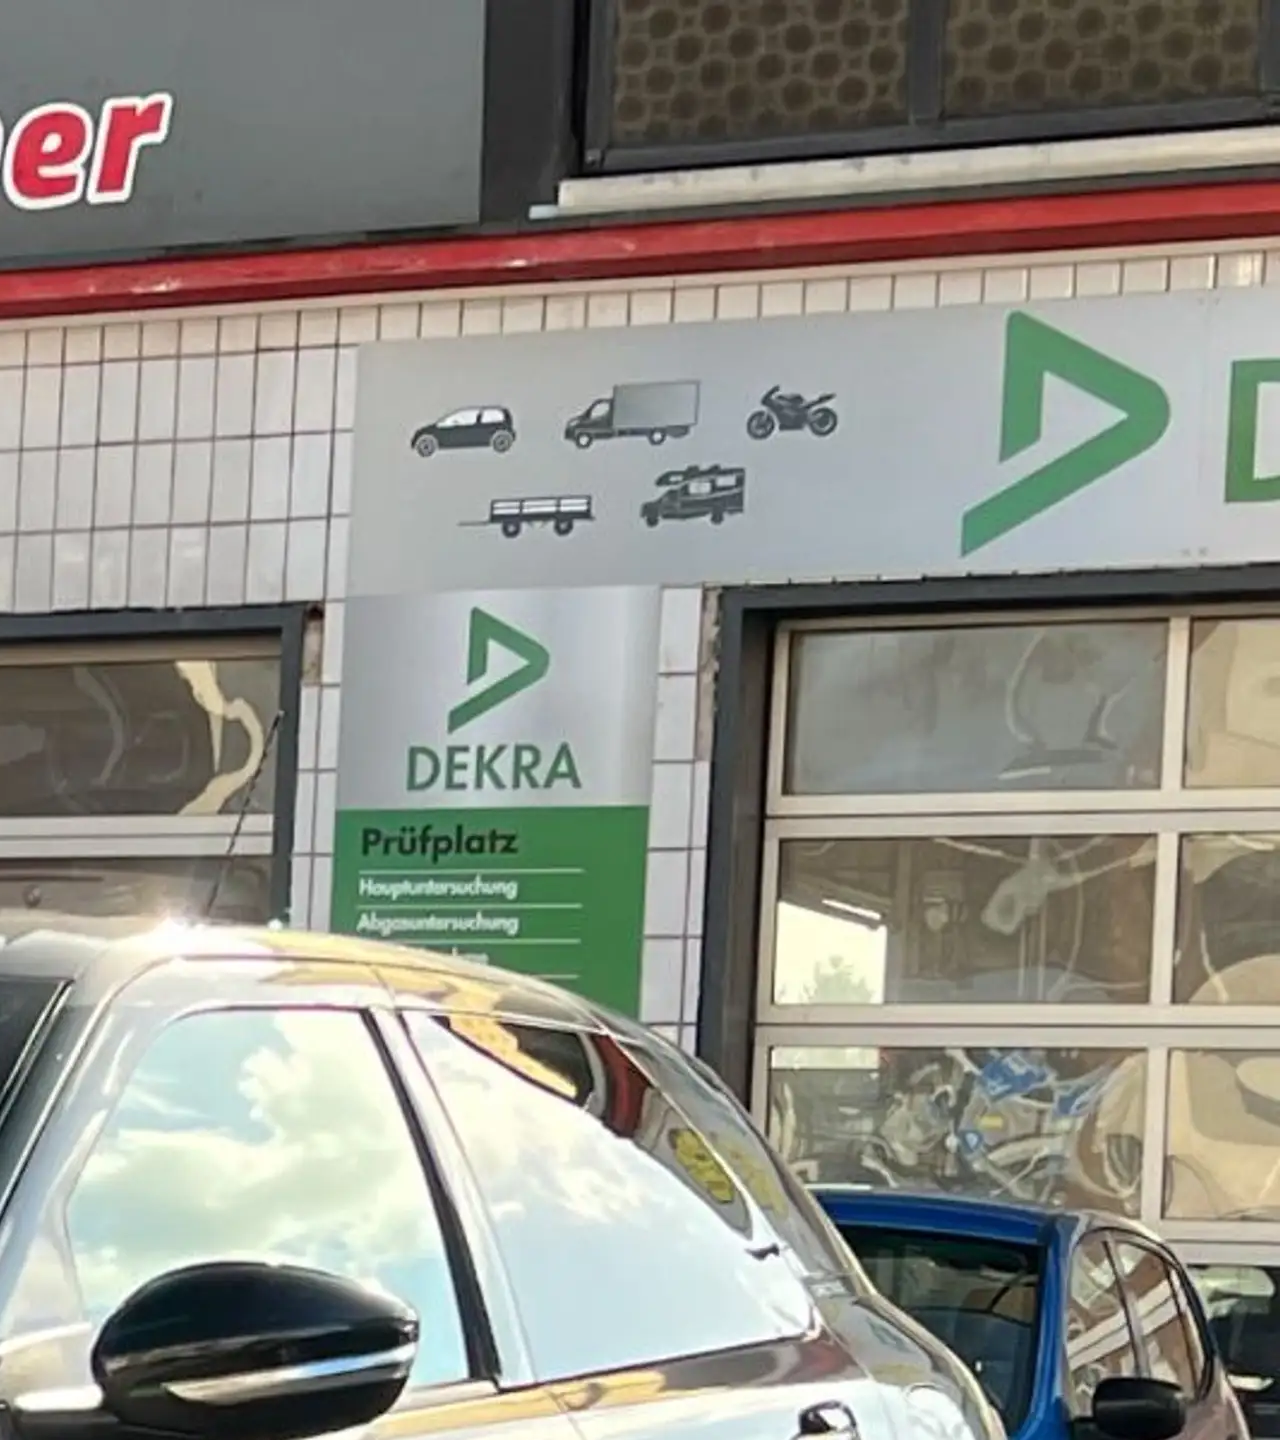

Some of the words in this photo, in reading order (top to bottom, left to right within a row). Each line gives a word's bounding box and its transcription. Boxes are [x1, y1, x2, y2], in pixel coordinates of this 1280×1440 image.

[405, 742, 582, 792] DEKRA
[361, 825, 519, 864] Prüfplatz
[359, 874, 519, 899] Hauptuntersuchung
[357, 911, 519, 936] Abgasuntersuchung
